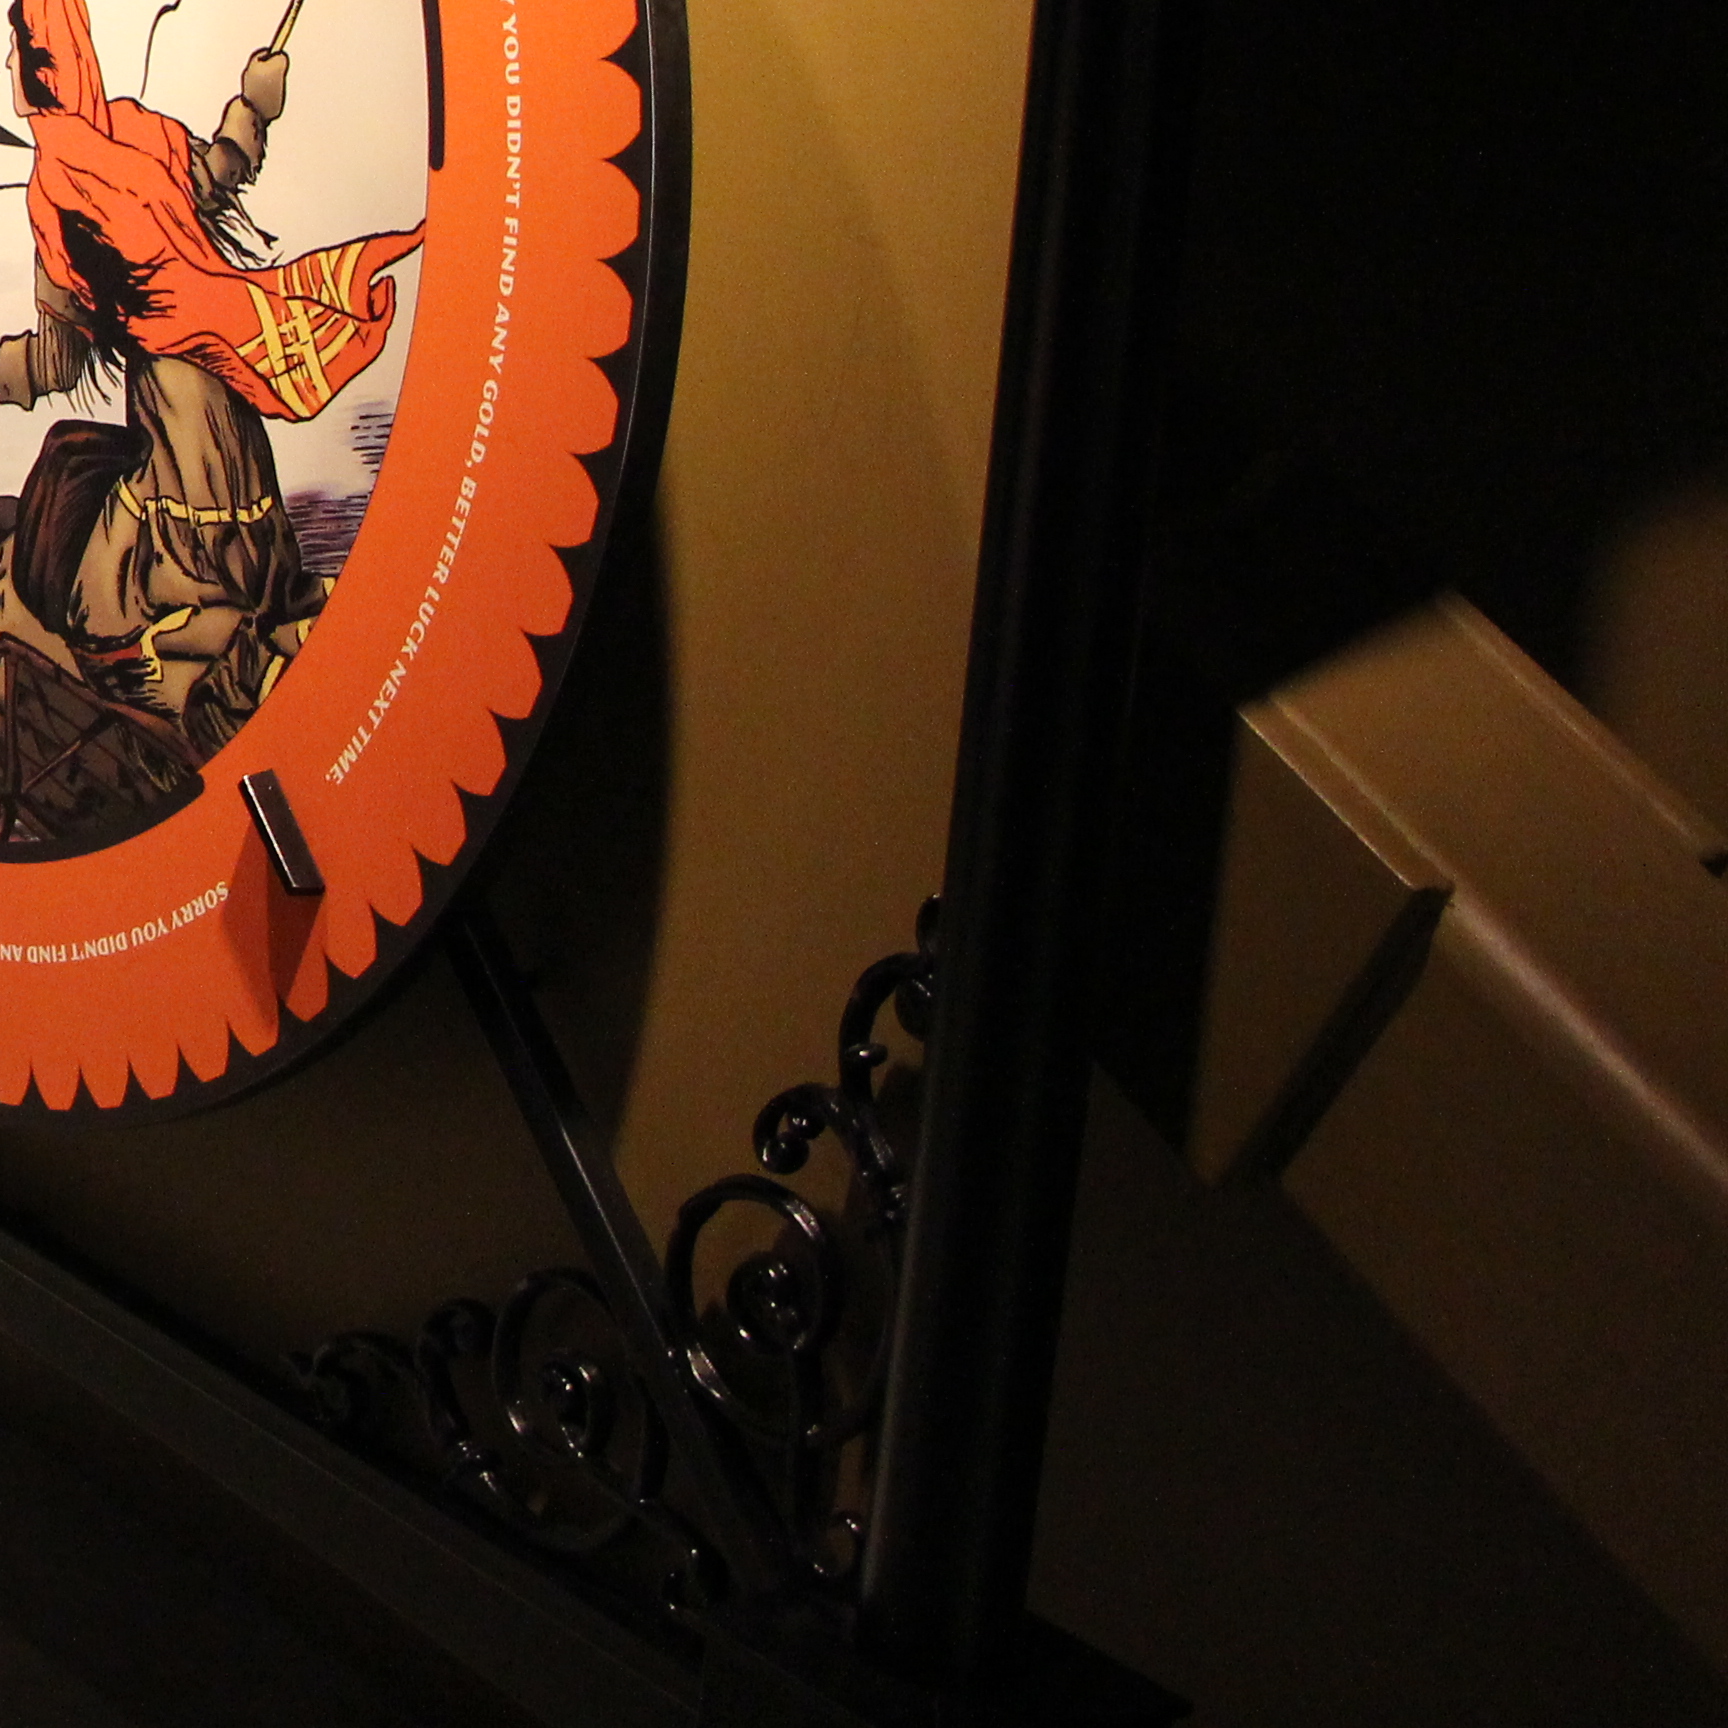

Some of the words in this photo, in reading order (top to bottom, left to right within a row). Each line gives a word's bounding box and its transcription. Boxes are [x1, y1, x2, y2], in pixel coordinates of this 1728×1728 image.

[500, 13, 521, 86] YOU
[506, 96, 522, 210] DIDN'T
[498, 216, 520, 298] FIND
[488, 301, 511, 375] ANY
[464, 379, 499, 468] GOLD,
[432, 475, 478, 584] BETTER
[403, 585, 440, 661] LUCK
[367, 660, 407, 730] NEXT
[324, 727, 373, 785] TIME.
[131, 918, 168, 946] YOU
[171, 881, 229, 930] SORRY
[27, 945, 67, 963] FIND
[71, 931, 128, 961] DIDN'T
